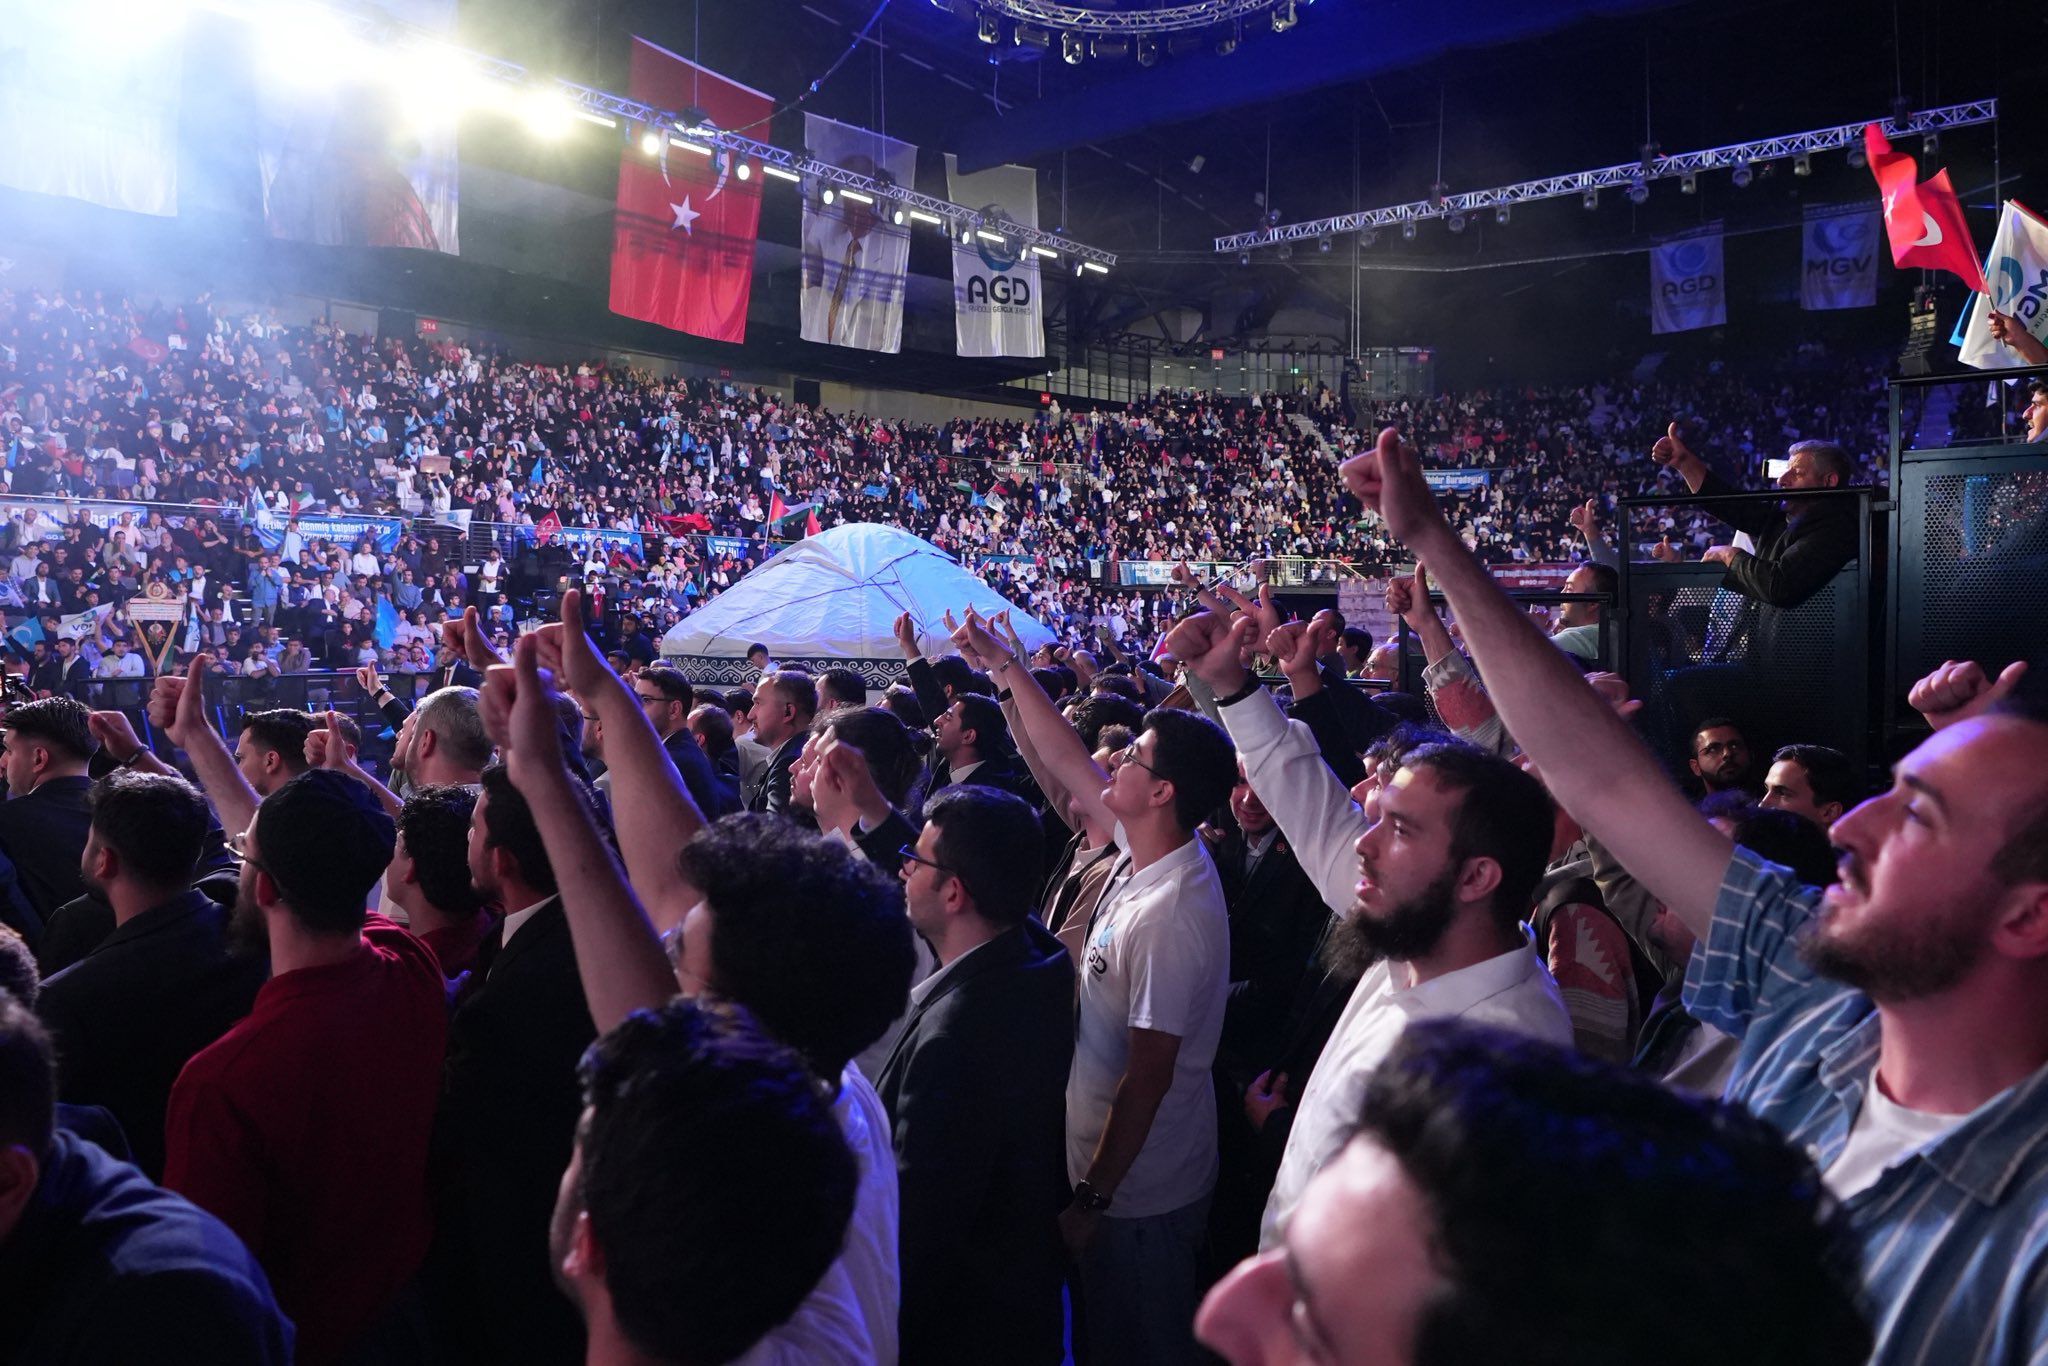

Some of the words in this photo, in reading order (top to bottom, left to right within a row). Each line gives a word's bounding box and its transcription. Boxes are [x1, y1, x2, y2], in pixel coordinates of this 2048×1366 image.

[1807, 255, 1872, 276] MGV
[967, 274, 1030, 306] AGD
[1662, 275, 1716, 298] AGD
[1089, 946, 1107, 975] GD
